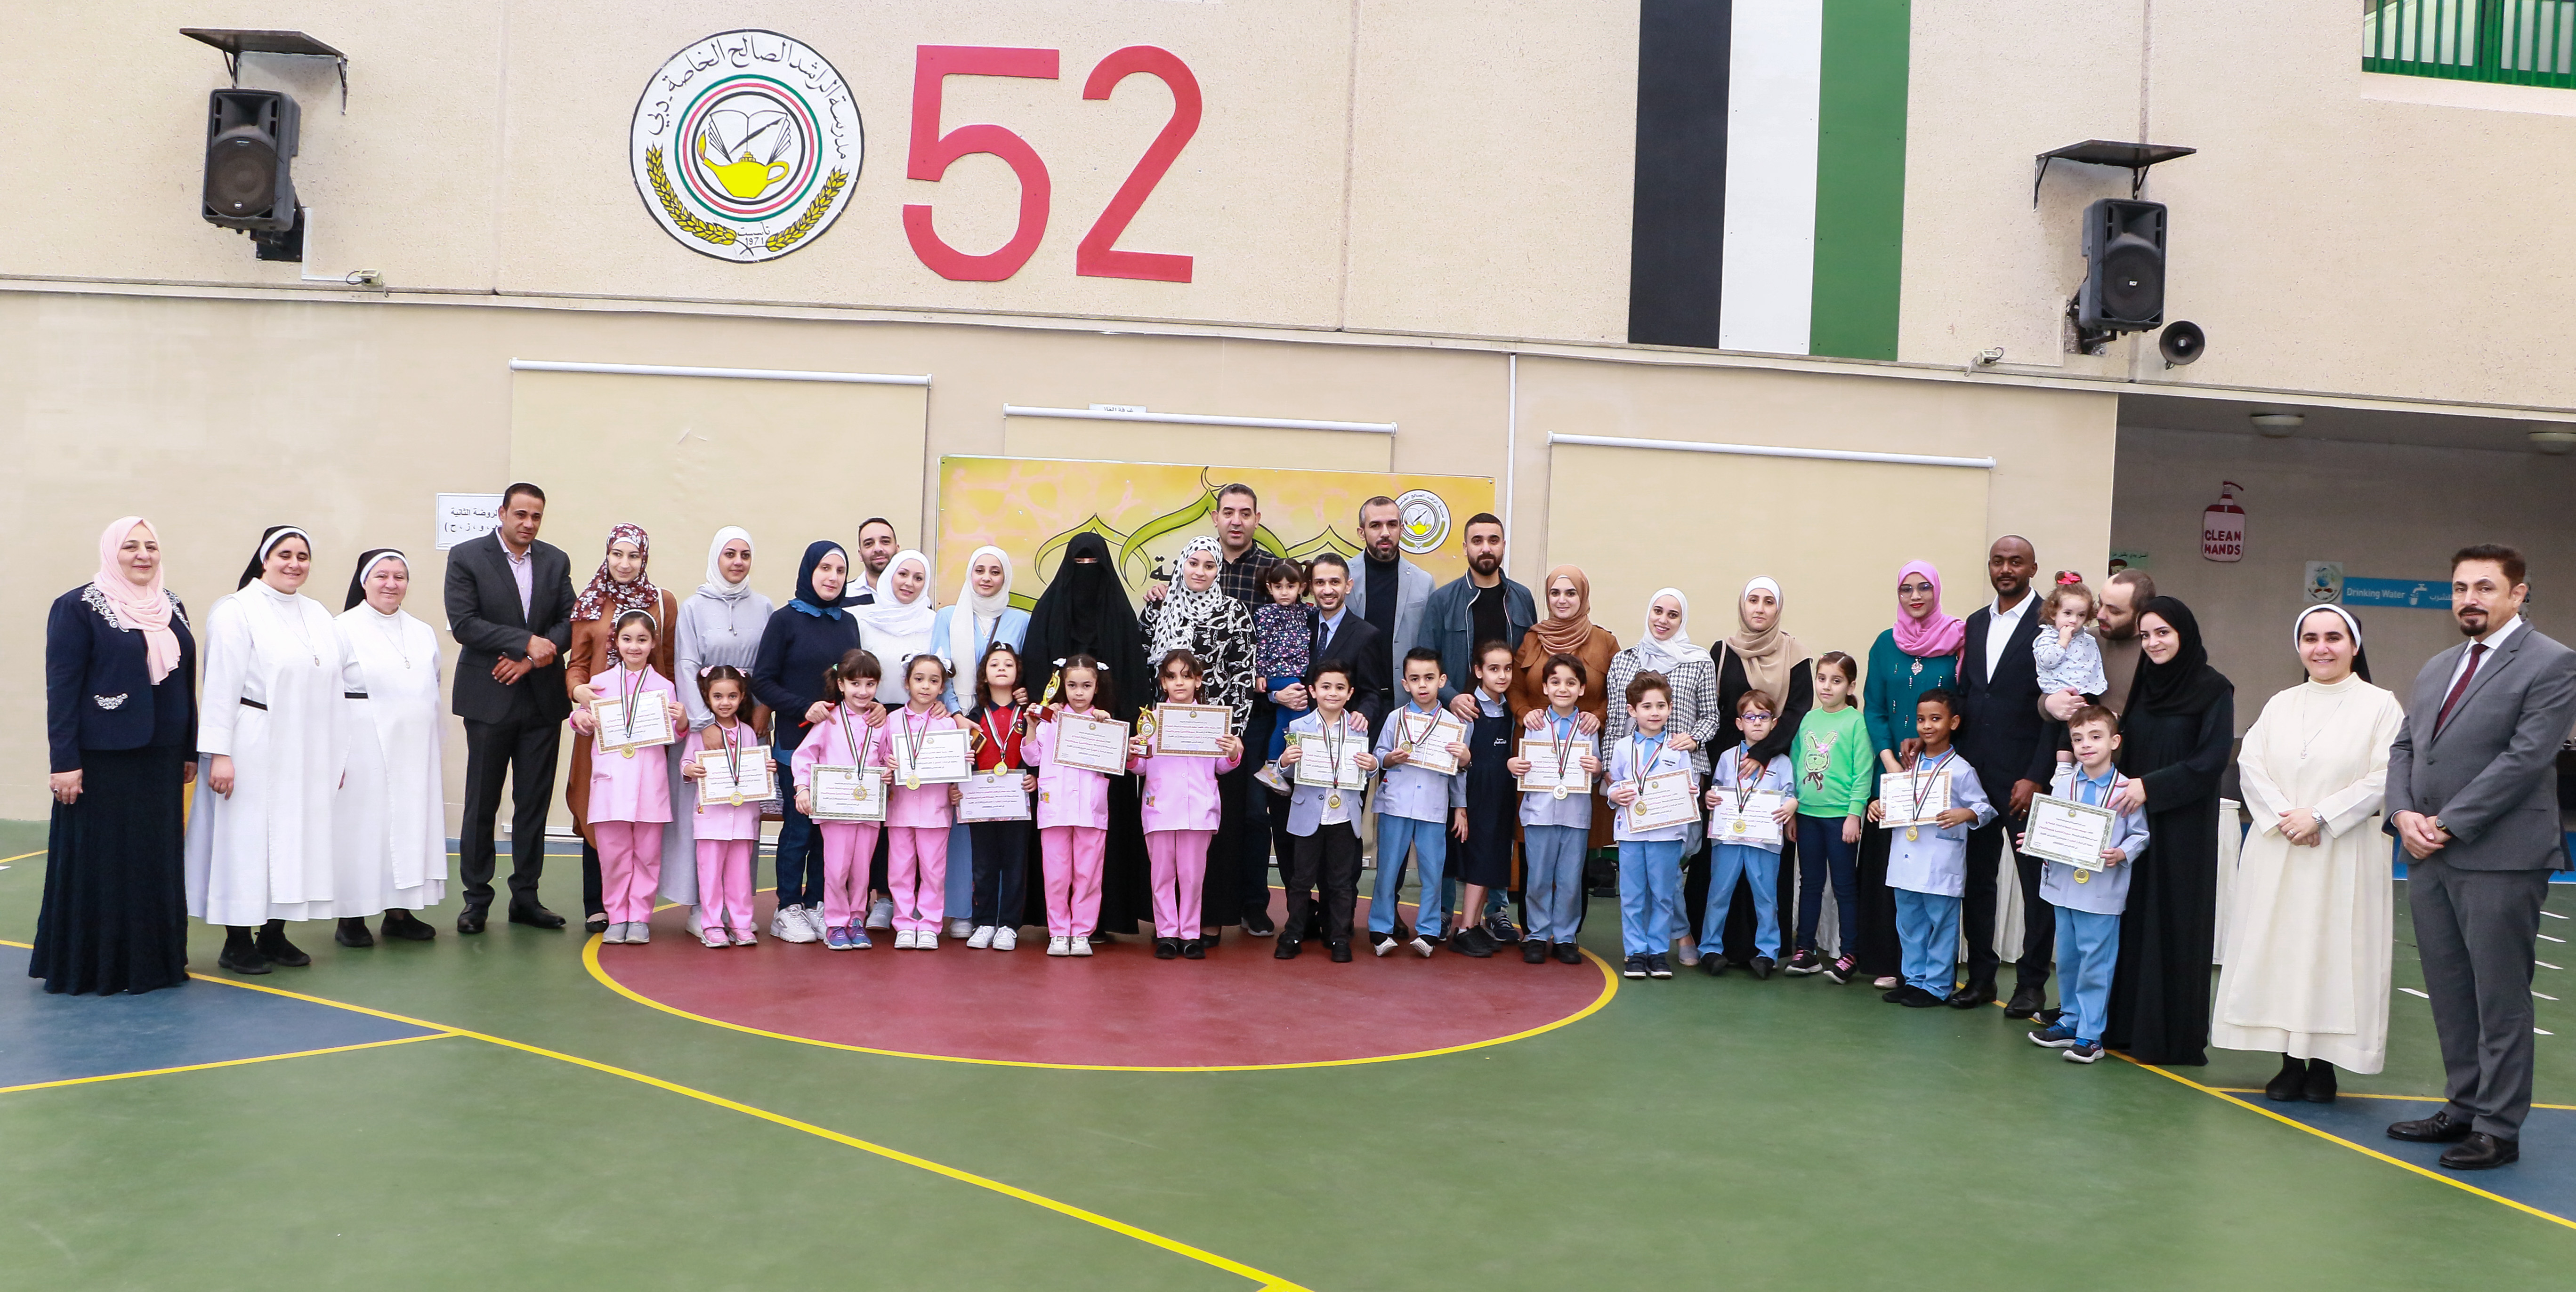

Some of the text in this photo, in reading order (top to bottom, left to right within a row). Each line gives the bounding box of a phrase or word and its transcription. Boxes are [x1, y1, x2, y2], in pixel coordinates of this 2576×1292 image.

[662, 38, 726, 91] الخاصة
[728, 35, 793, 68] الصالح
[789, 58, 842, 98] الراشد
[647, 101, 670, 136] دبي
[828, 95, 849, 160] مدرسة
[903, 45, 1202, 282] 52
[745, 237, 764, 245] 1971
[451, 507, 498, 518] لروضة الثانية
[2205, 530, 2241, 541] CLEAN
[2205, 544, 2241, 555] HANDS
[2347, 588, 2406, 599] Drinking Water
